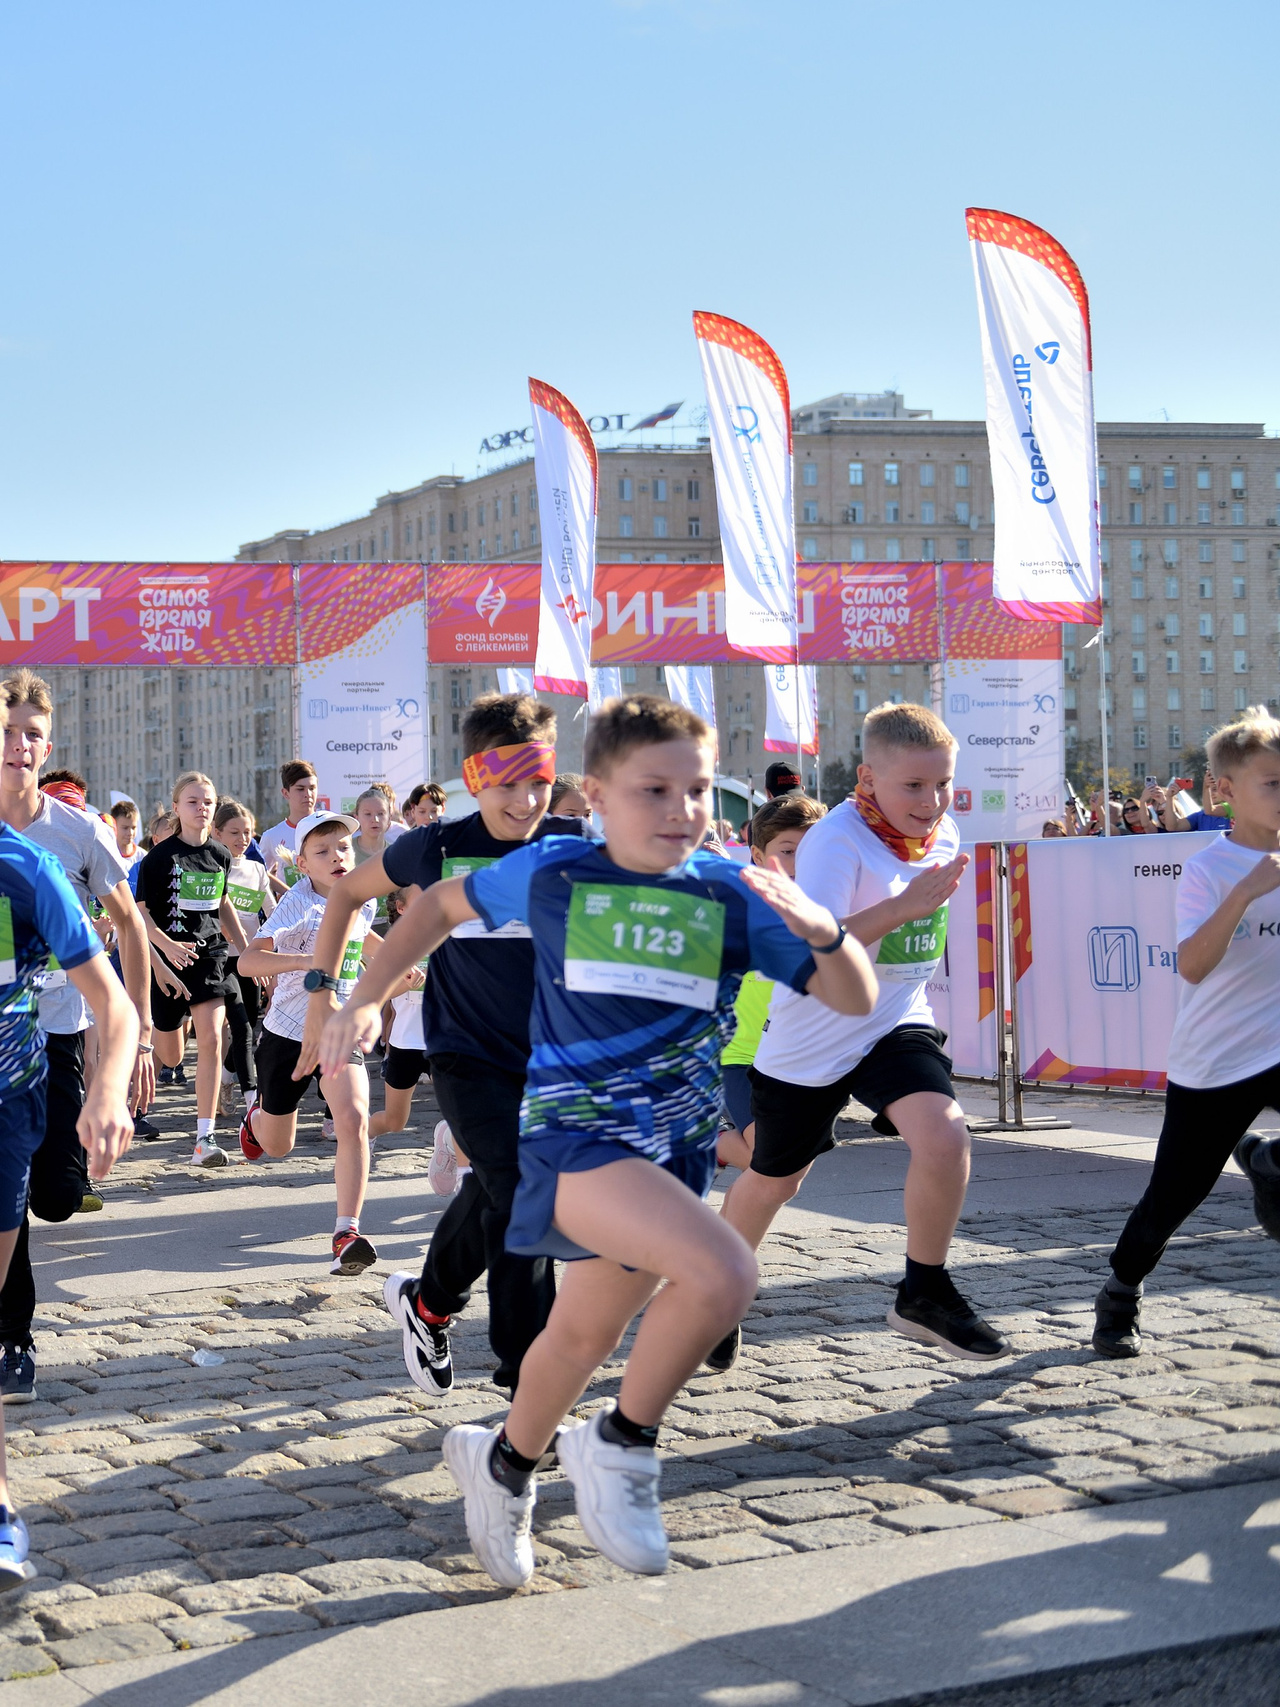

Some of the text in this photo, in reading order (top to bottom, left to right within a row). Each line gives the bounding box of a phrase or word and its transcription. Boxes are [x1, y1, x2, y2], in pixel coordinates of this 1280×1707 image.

[479, 414, 630, 454] АЭРООТ
[455, 632, 529, 644] ФОНД БОРЬБЫ
[455, 641, 529, 653] С ЛЕЙКЕМИЕЙ
[326, 740, 398, 754] Северсталь
[967, 734, 1036, 748] Северсталь
[1133, 863, 1182, 878] генер
[195, 885, 217, 896] 1172
[232, 896, 253, 908] 1027
[612, 922, 685, 957] 1123
[904, 933, 936, 953] 1156
[926, 982, 950, 993] РОЧКА
